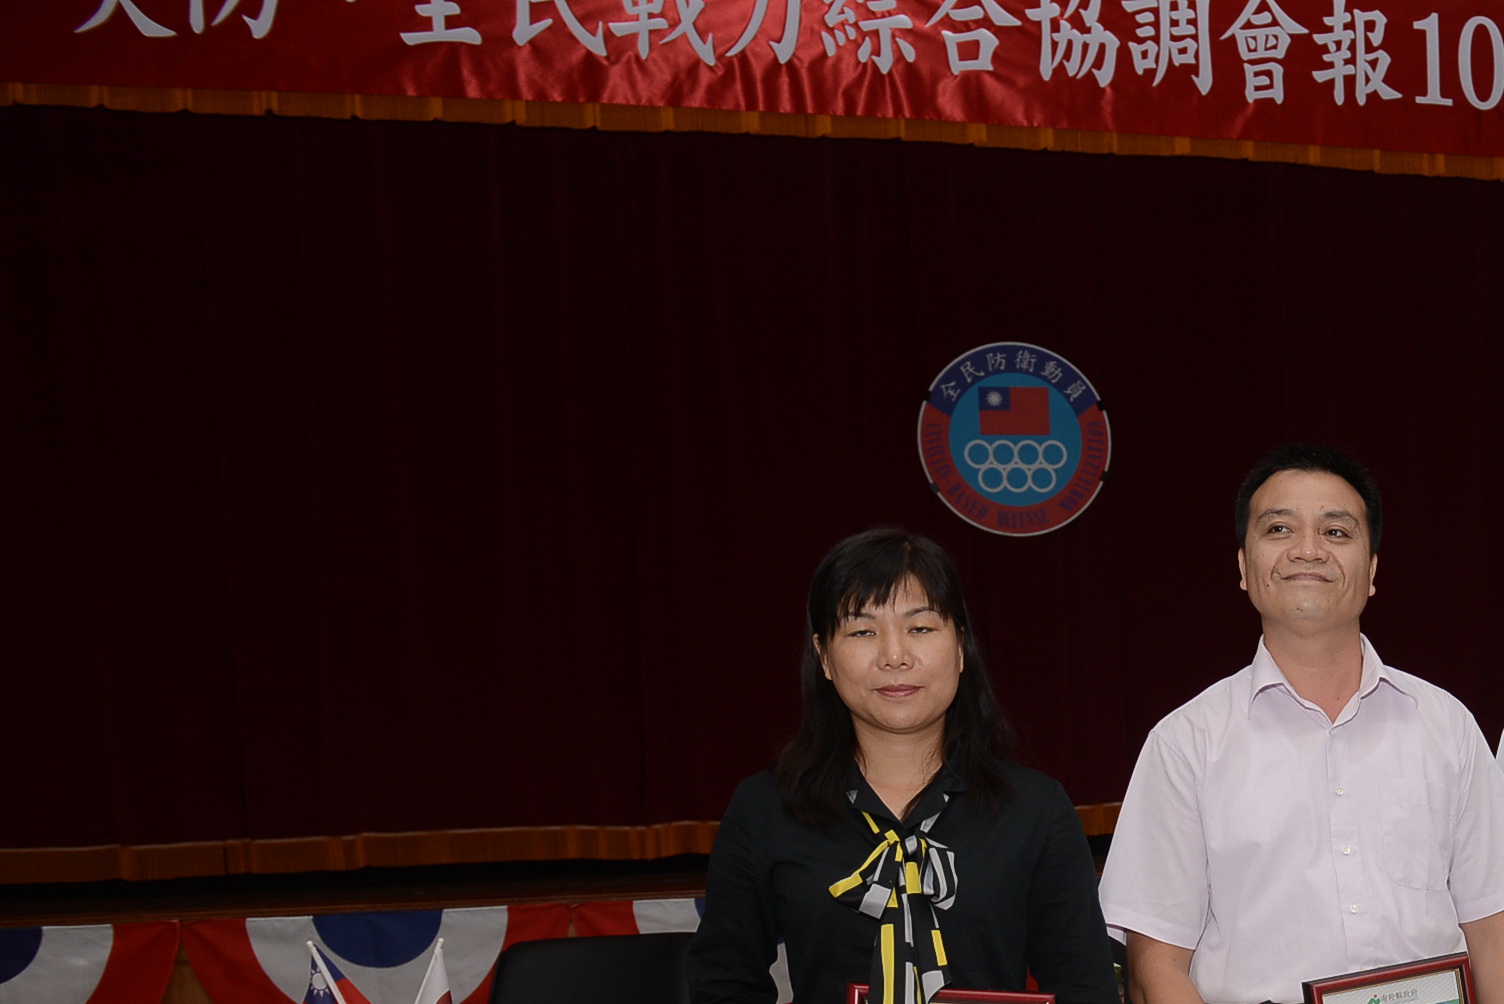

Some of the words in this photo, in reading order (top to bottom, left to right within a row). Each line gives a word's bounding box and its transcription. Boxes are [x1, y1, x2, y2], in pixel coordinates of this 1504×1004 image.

[940, 350, 1087, 402] 全民防衛動員
